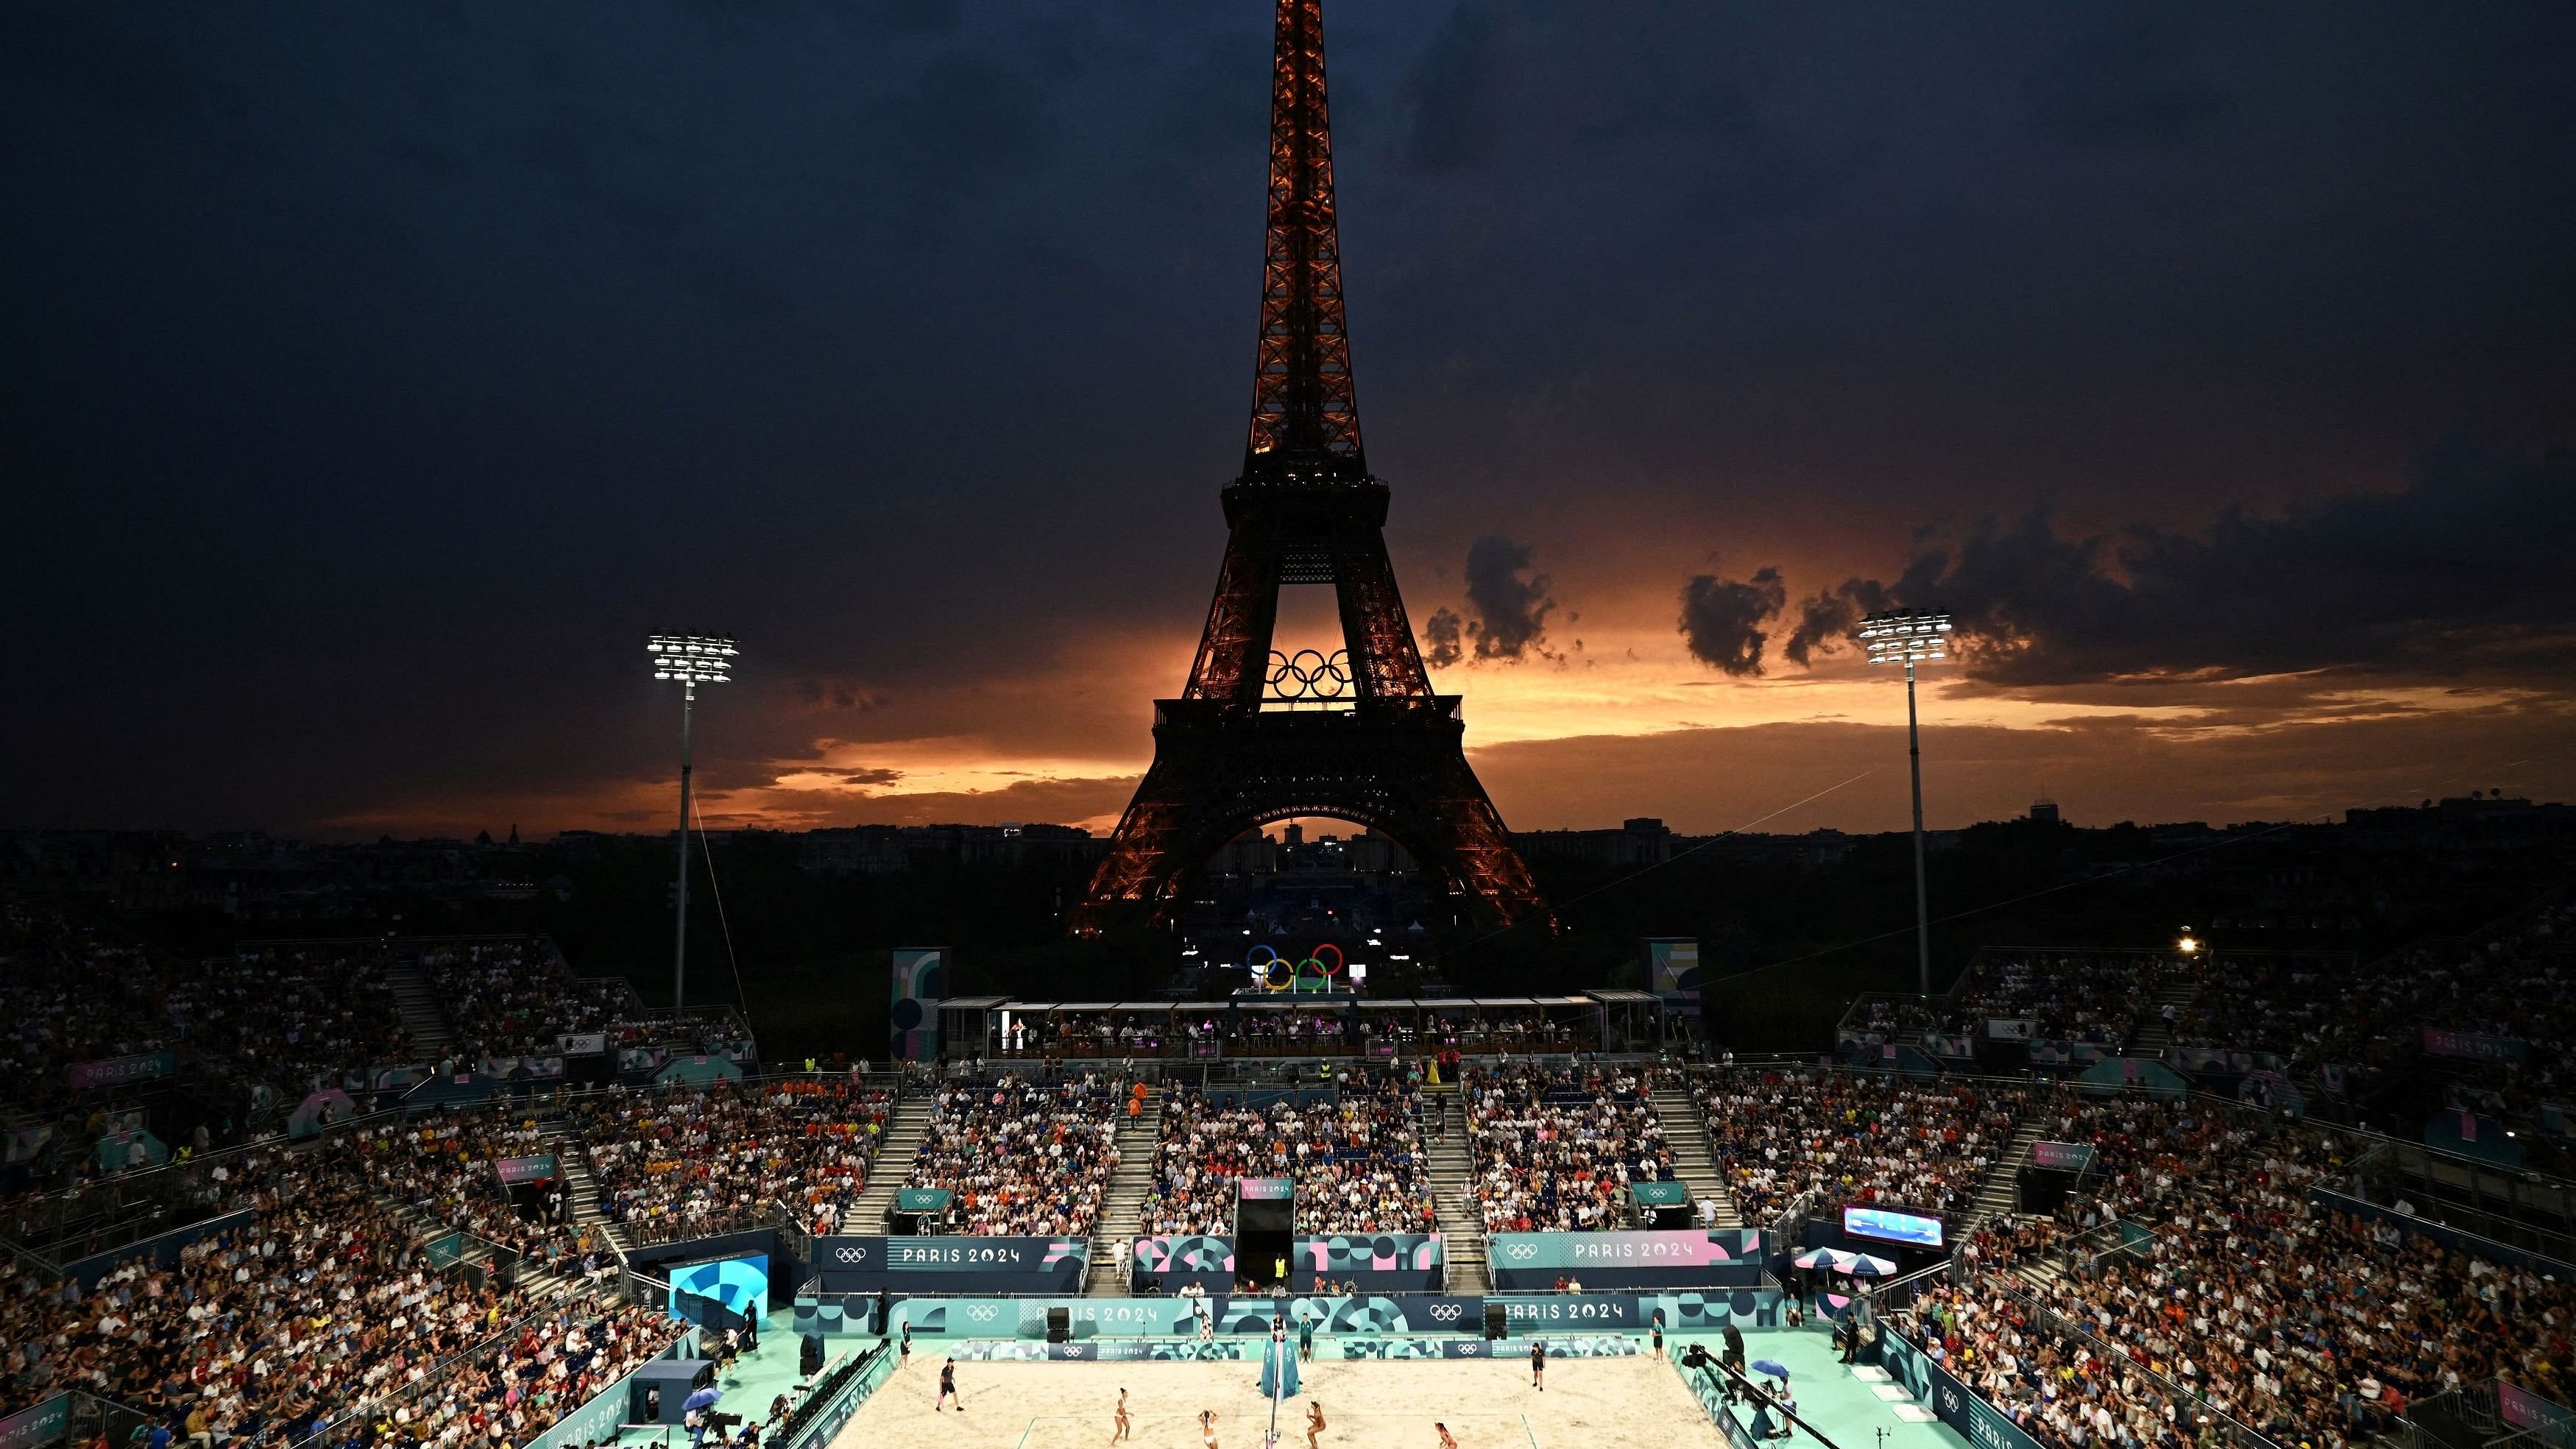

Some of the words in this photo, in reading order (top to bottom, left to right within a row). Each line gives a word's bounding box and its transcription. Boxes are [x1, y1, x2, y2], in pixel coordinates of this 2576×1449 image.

[969, 1248, 1019, 1263] 2024
[1641, 1242, 1692, 1257] 2024
[1104, 1307, 1157, 1322] 2024
[1568, 1303, 1623, 1319] 2024
